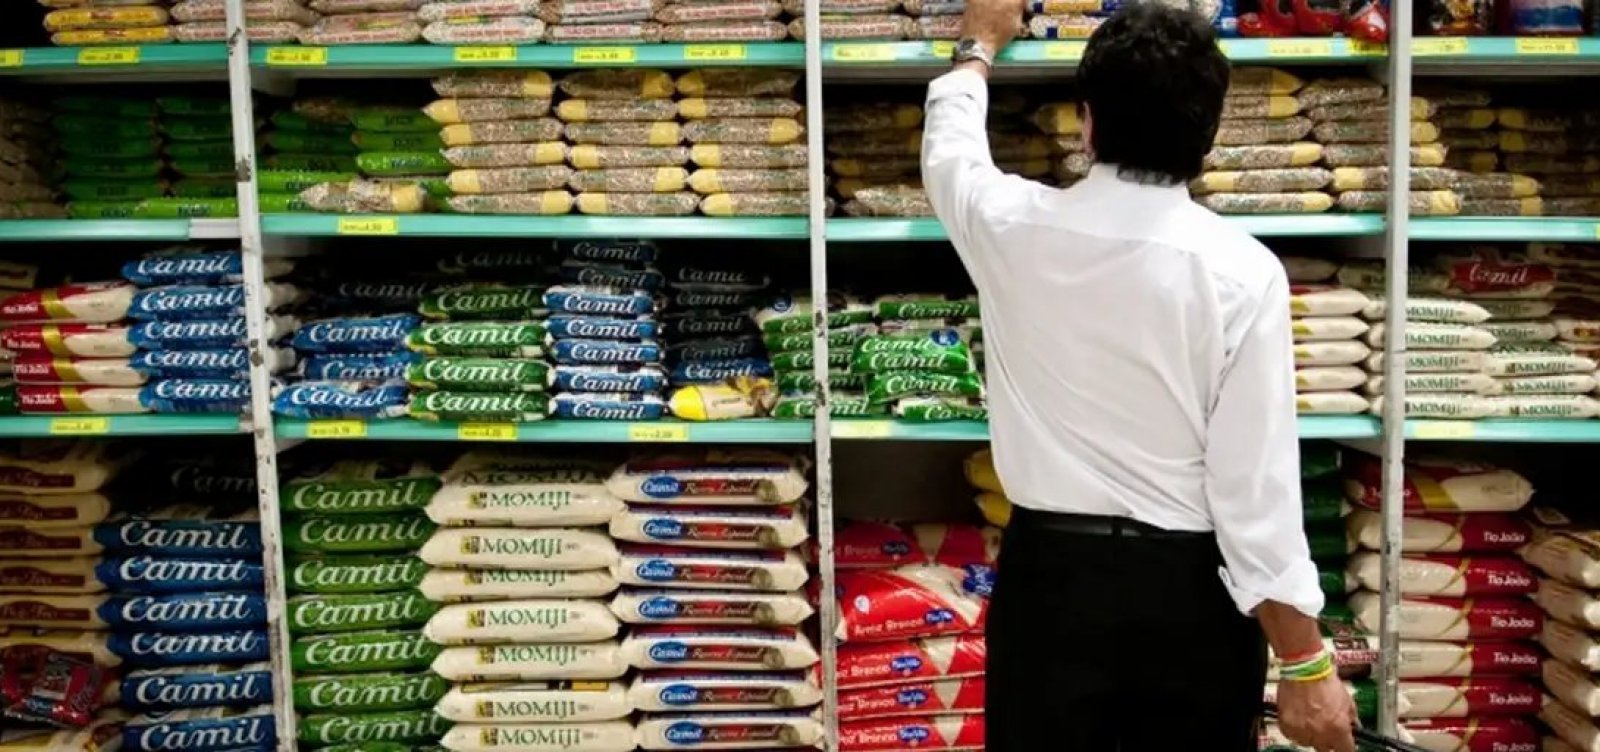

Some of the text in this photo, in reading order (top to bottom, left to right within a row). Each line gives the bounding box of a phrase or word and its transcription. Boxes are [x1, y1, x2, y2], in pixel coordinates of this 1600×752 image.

[574, 242, 640, 261] Camil
[138, 254, 231, 275] Camil
[1469, 264, 1528, 284] Camil
[141, 287, 243, 311] Camil
[438, 289, 531, 312] Camil
[564, 294, 636, 313] Camil
[145, 315, 247, 339] Camil
[310, 320, 405, 341] Camil
[423, 322, 526, 345] Camil
[567, 319, 639, 337] Camil
[145, 350, 246, 368] Camil
[571, 342, 643, 361] Camil
[870, 352, 948, 369] Camil
[426, 359, 526, 381] Camil
[570, 372, 642, 391] Camil
[292, 386, 386, 407] Camil
[426, 392, 527, 411] Camil
[573, 400, 645, 418] Camil
[295, 481, 419, 509] Camil
[491, 491, 571, 510] MOMIJI
[121, 522, 247, 549] Camil
[300, 517, 423, 544] Camil
[482, 537, 561, 557] MOMIJI
[121, 556, 247, 582] Camil
[294, 560, 423, 586] Camil
[486, 569, 565, 586] MOMIJI
[123, 594, 249, 622] Camil
[295, 596, 420, 626] Camil
[488, 608, 567, 628] MOMIJI
[132, 631, 259, 655] Camil
[305, 637, 432, 665] Camil
[499, 646, 577, 665] MOMIJI
[136, 674, 259, 704] Camil
[310, 677, 435, 706] Camil
[498, 700, 575, 720] MOMIJI
[142, 718, 265, 750] Camil
[320, 713, 443, 744] Camil
[499, 728, 580, 748] MOMIJI
